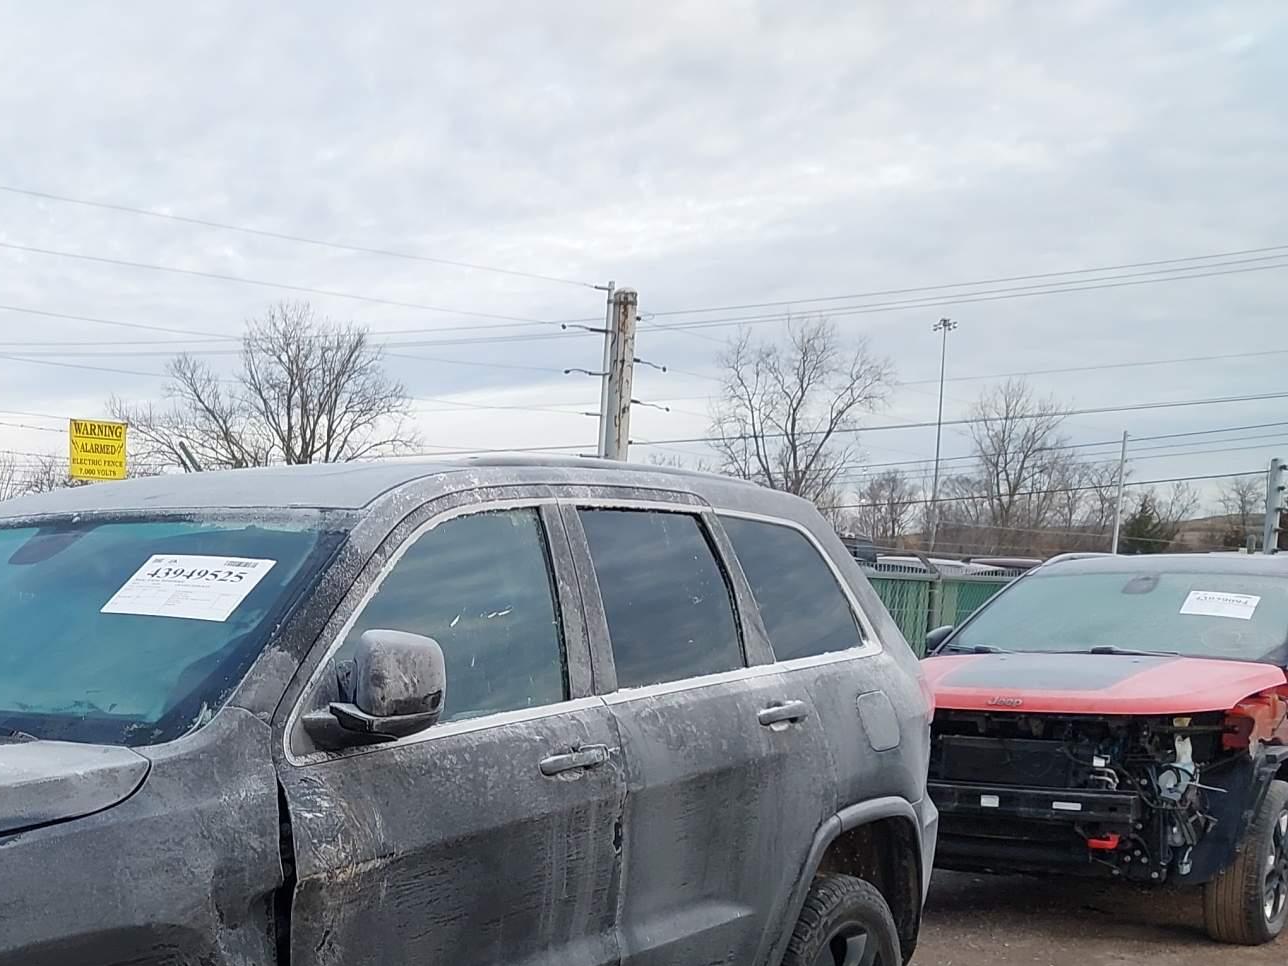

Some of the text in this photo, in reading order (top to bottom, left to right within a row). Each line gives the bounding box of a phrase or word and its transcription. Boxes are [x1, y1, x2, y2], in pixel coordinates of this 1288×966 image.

[73, 422, 123, 438] WARNING
[80, 442, 116, 455] ALARMED
[72, 458, 123, 468] ELECTRIC FENCE
[97, 469, 117, 477] VOLTS
[147, 566, 248, 584] 43949525
[987, 695, 1023, 707] Jeep
